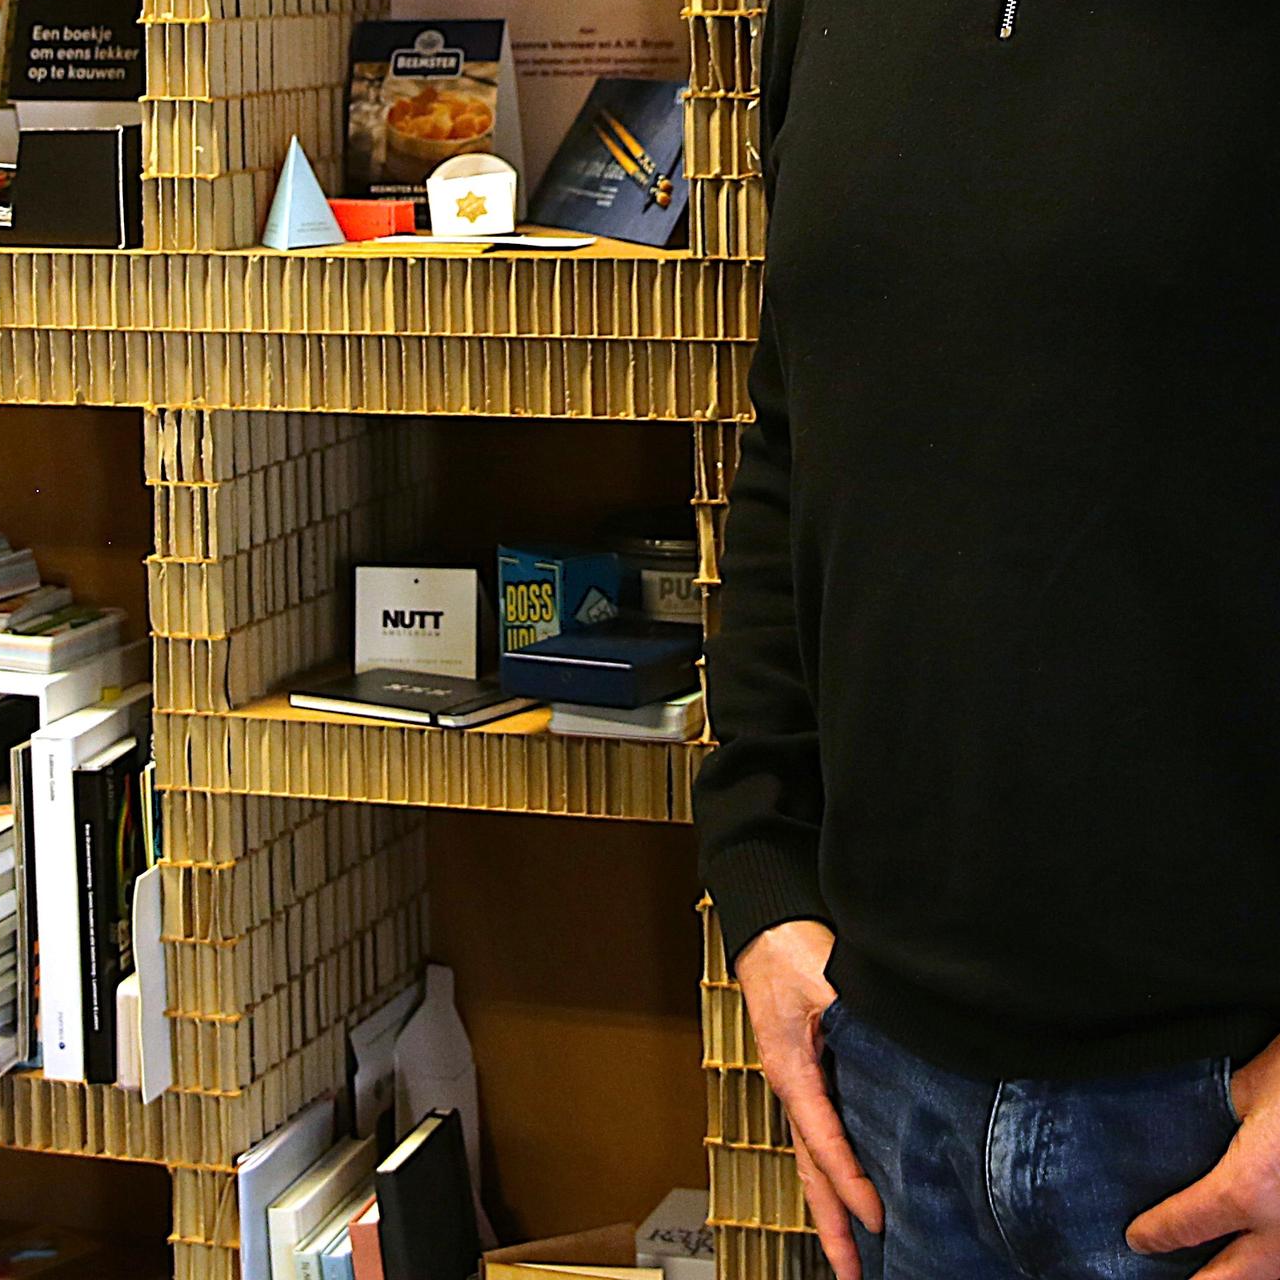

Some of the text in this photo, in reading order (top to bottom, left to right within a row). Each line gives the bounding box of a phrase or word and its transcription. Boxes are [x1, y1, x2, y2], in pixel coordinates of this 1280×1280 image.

[32, 24, 113, 45] Een boekje
[29, 44, 141, 61] om eens lekker
[27, 63, 126, 82] op te kauwen
[398, 55, 458, 72] BEEMSTER
[505, 582, 554, 622] BOSS
[382, 609, 445, 629] NUTT
